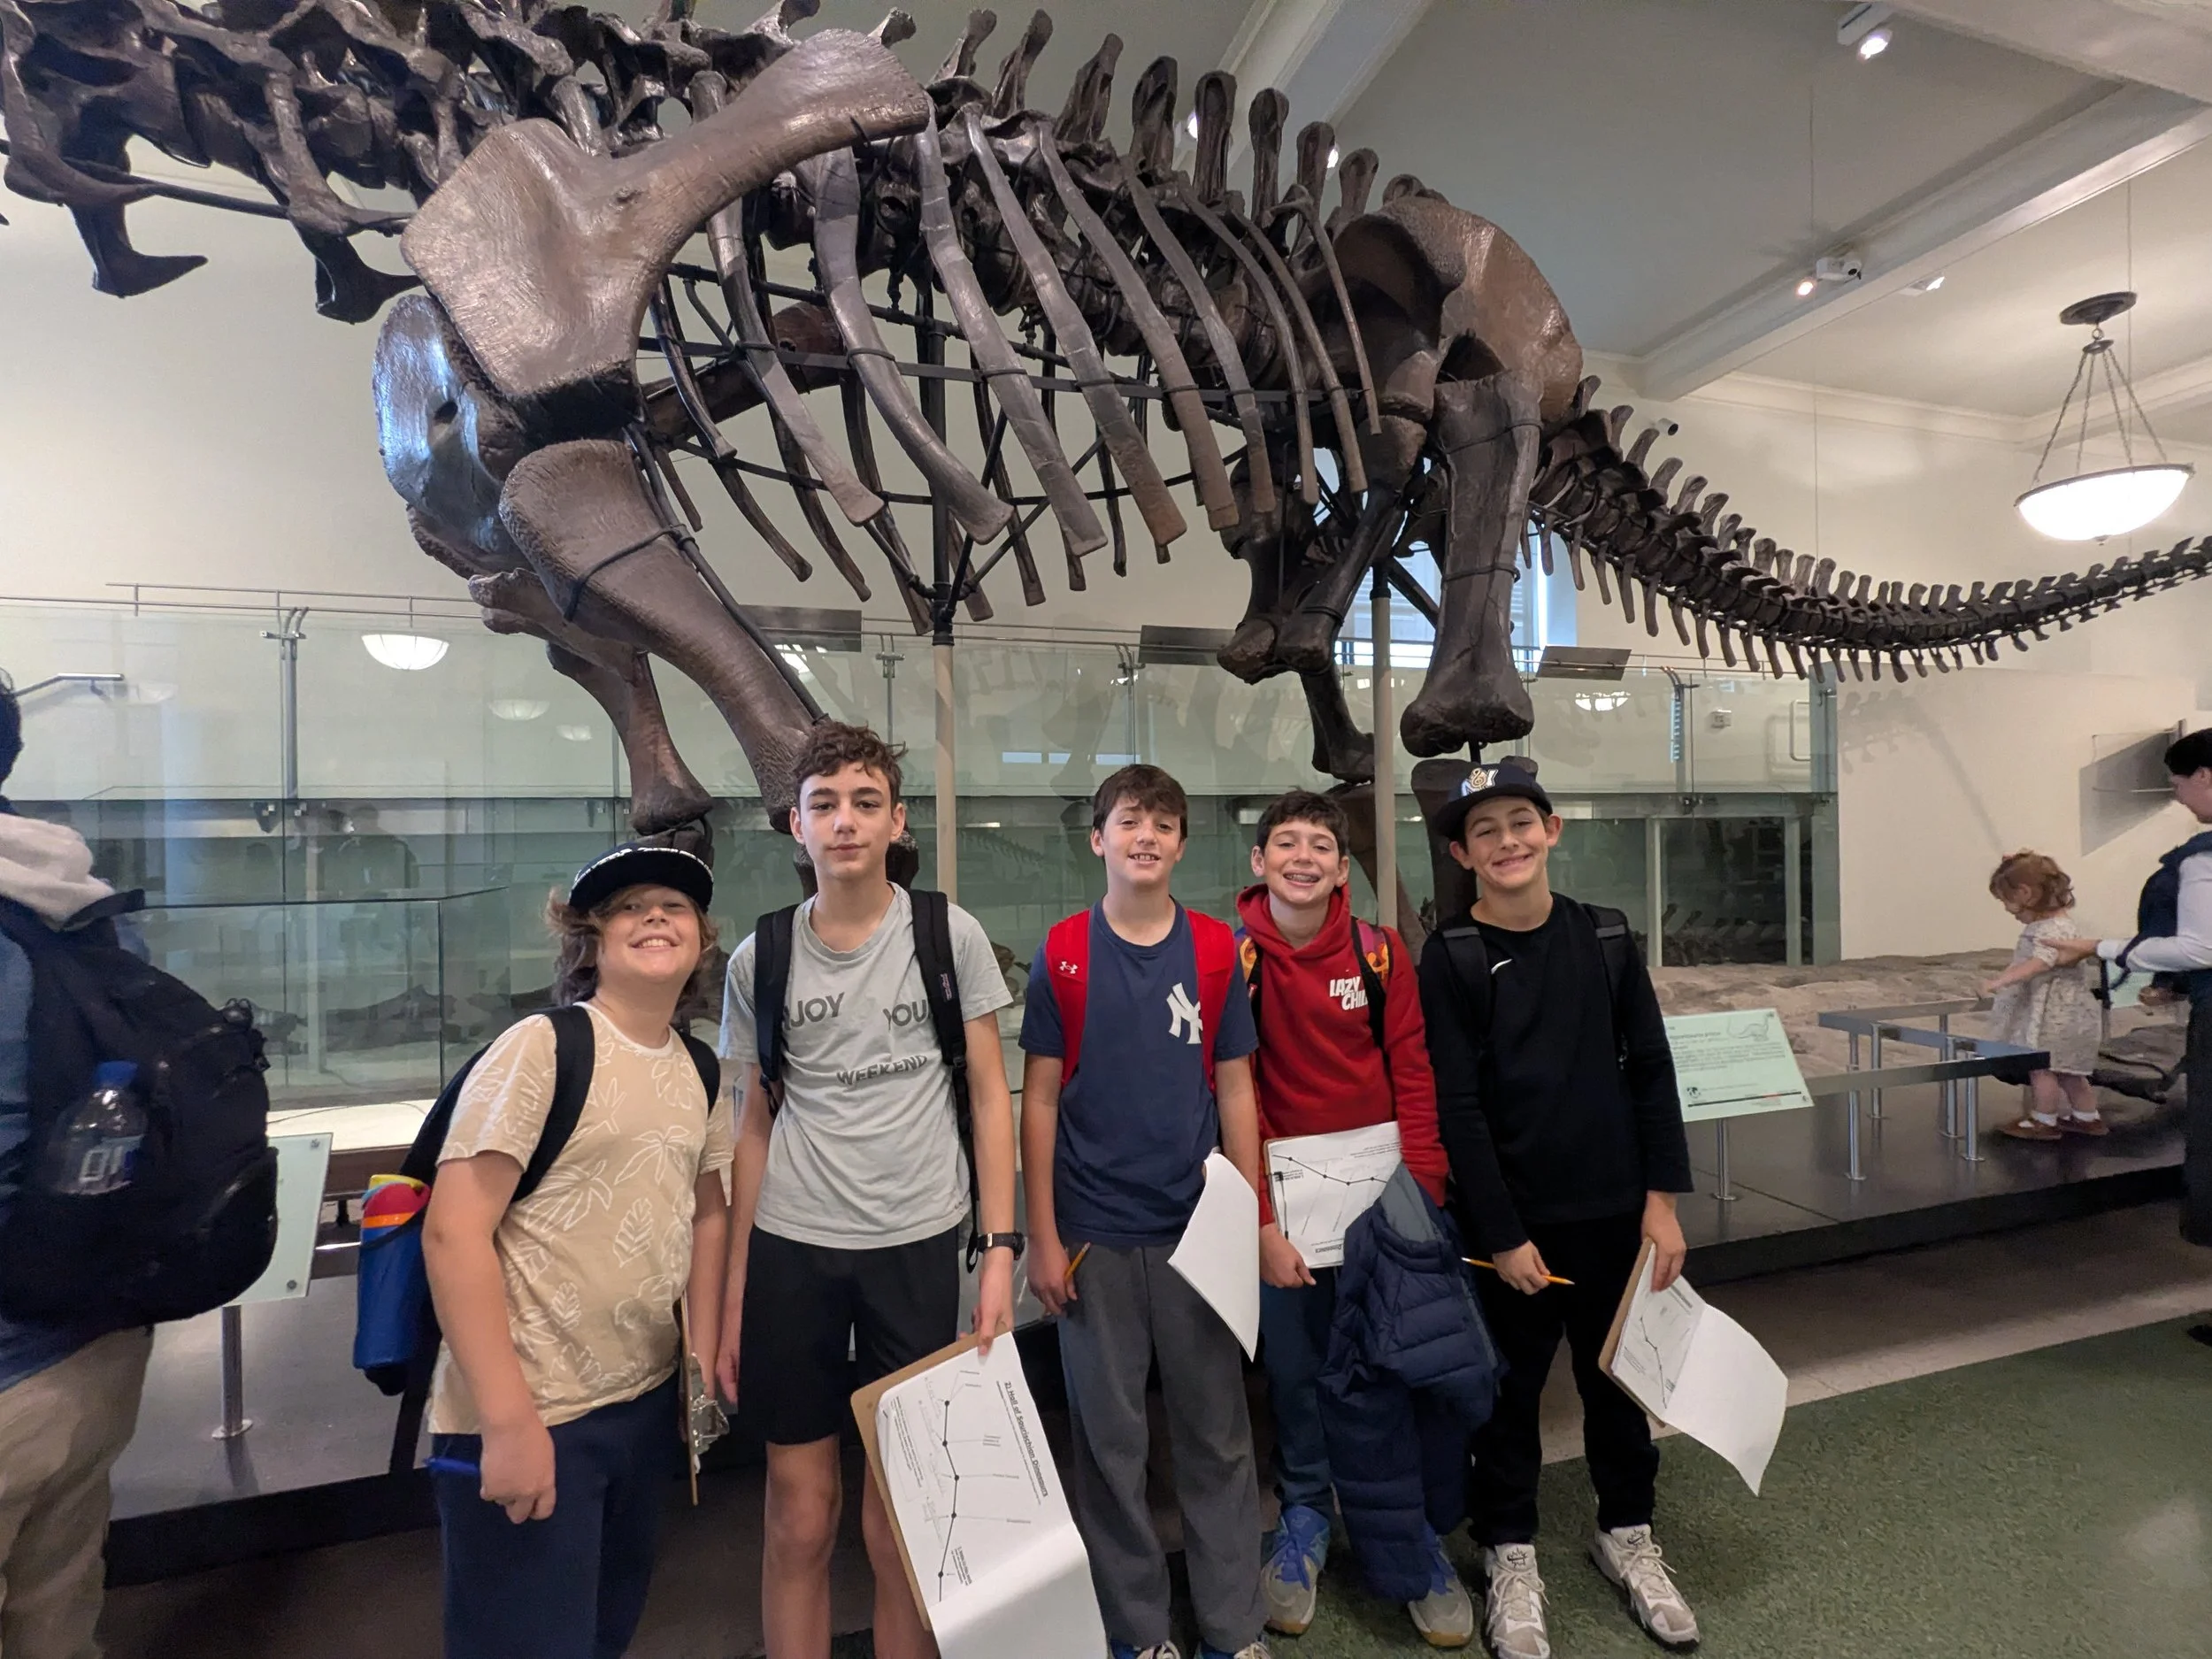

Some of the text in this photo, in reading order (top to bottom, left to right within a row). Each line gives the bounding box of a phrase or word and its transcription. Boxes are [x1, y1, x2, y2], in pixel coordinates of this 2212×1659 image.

[1330, 976, 1361, 997] LAZY
[836, 1055, 928, 1086] WEEKEND
[1009, 1391, 1018, 1405] Hall
[1014, 1406, 1022, 1415] of
[1017, 1416, 1035, 1458] Saurischian
